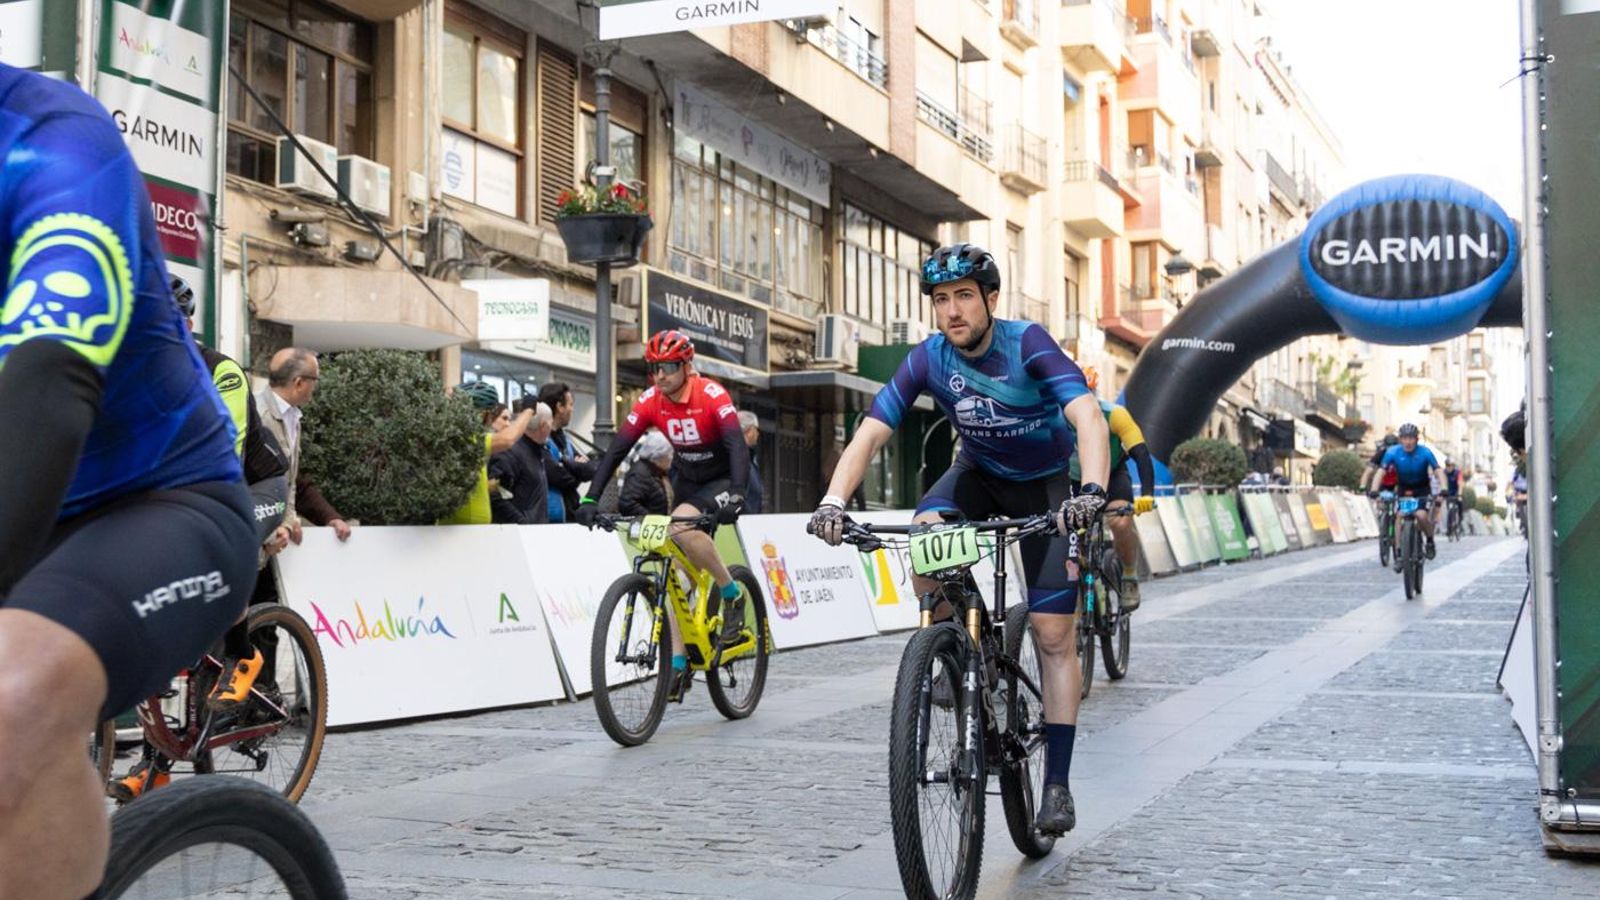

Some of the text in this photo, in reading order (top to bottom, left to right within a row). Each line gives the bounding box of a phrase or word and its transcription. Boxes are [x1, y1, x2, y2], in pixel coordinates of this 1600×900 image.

[675, 0, 759, 20] GARMIN
[112, 109, 203, 158] GARMIN
[665, 292, 754, 339] VERÓNICA Y JESÚS
[1161, 336, 1236, 353] garmin.com
[667, 418, 700, 443] CB
[642, 524, 666, 541] 673
[918, 531, 967, 565] 1071
[795, 566, 854, 582] AYUNTAMIENTO
[800, 589, 813, 604] DE
[312, 595, 456, 648] Andalucía
